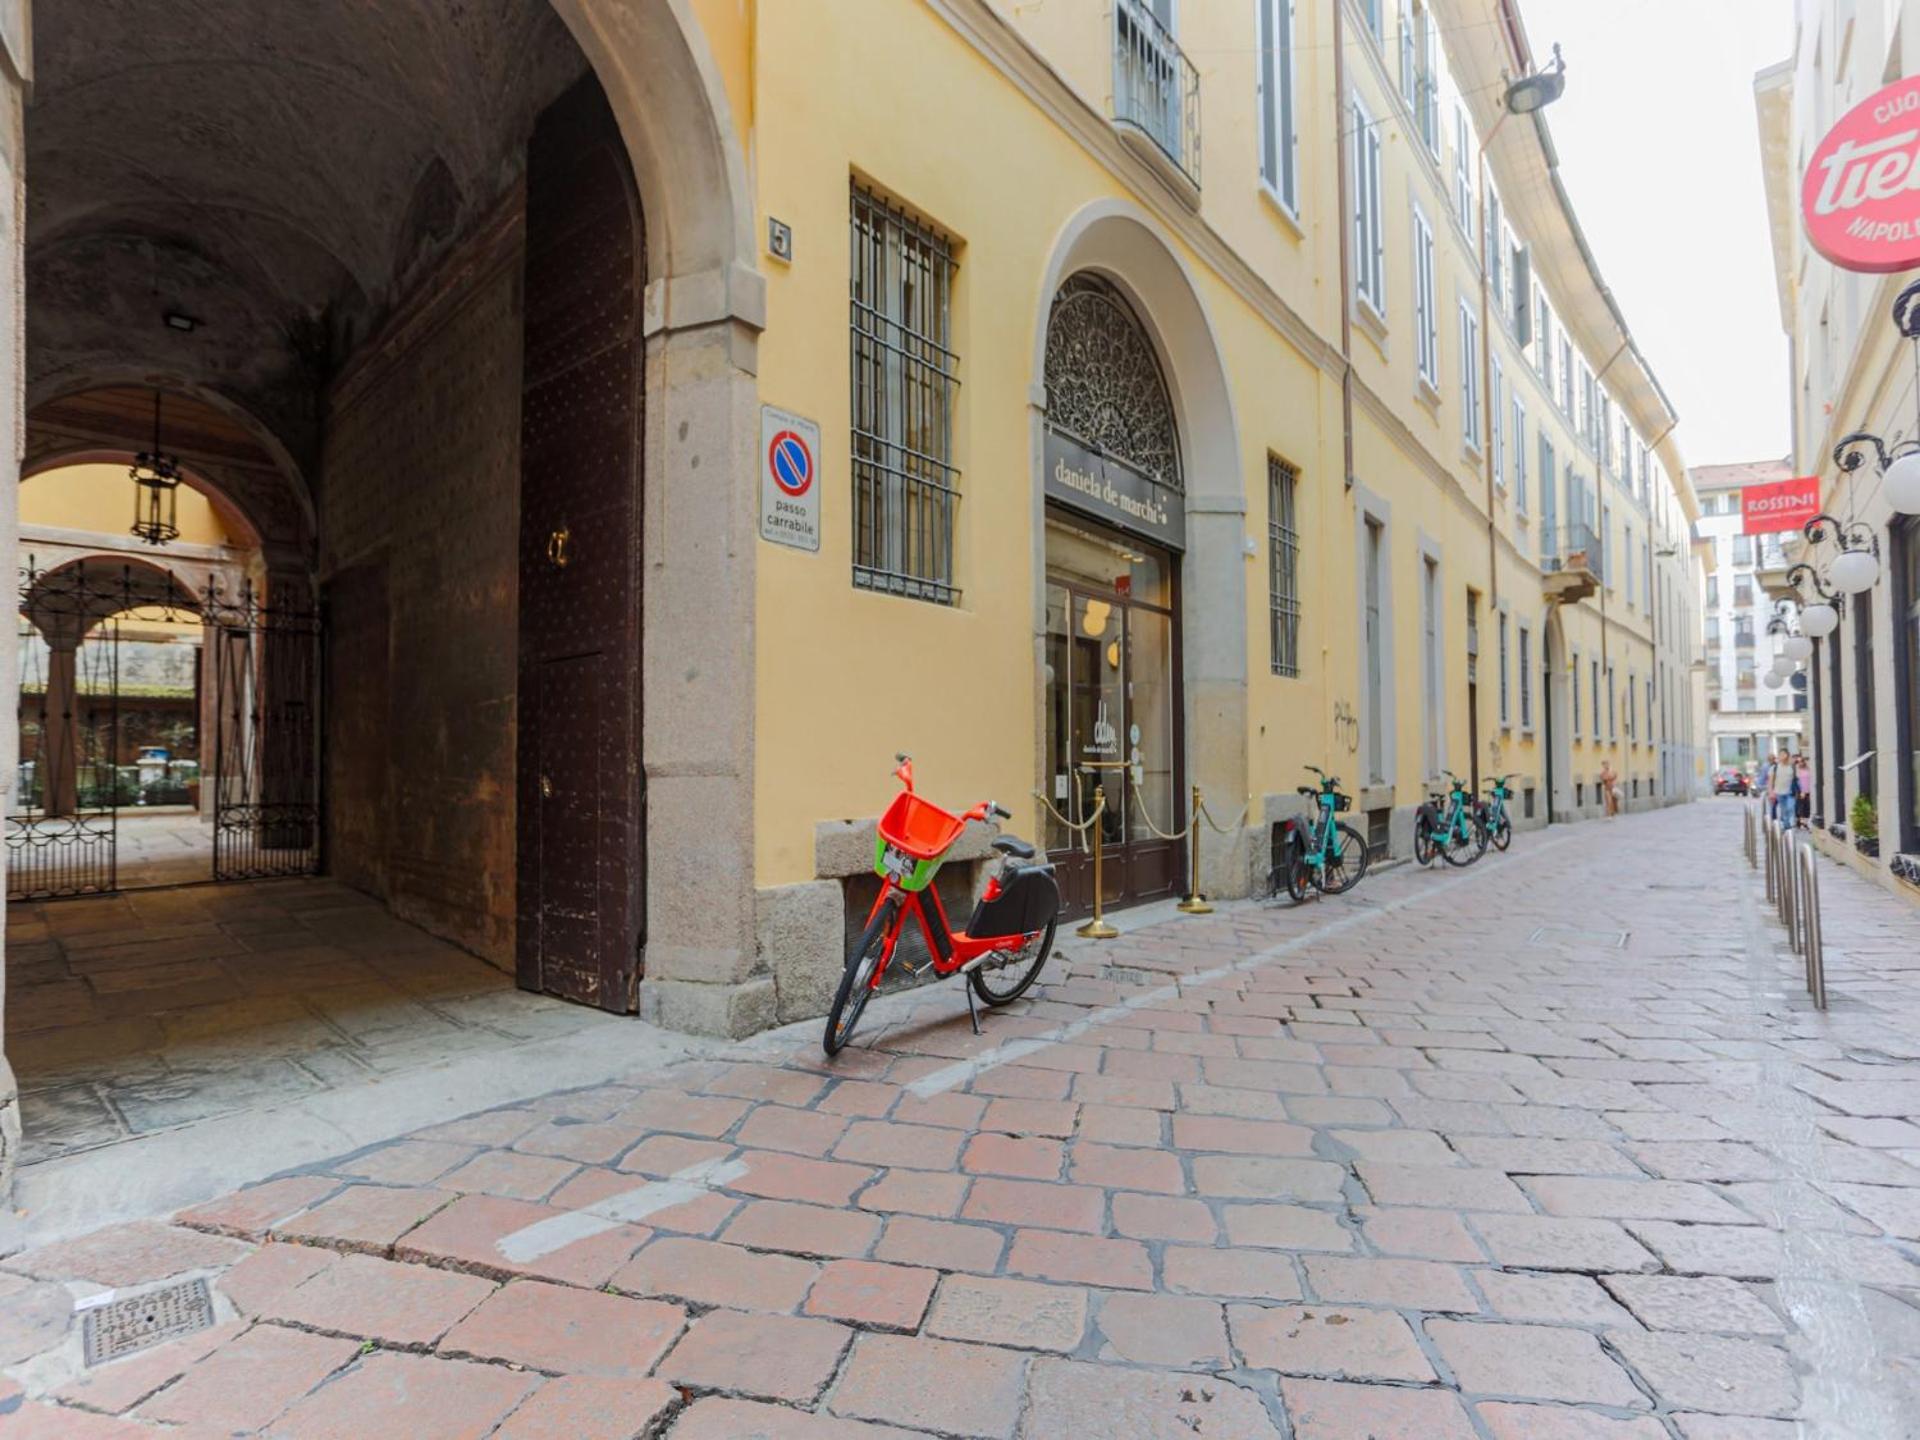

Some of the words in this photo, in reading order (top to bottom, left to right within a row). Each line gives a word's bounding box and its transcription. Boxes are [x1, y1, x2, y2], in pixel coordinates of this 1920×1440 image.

[1873, 91, 1920, 124] CUO
[774, 222, 787, 254] 5
[1055, 457, 1101, 499] daniela
[1103, 480, 1118, 507] de
[1119, 494, 1158, 524] marchi
[1747, 492, 1815, 512] ROSSINI
[776, 500, 806, 516] passo
[767, 514, 814, 535] carrabile
